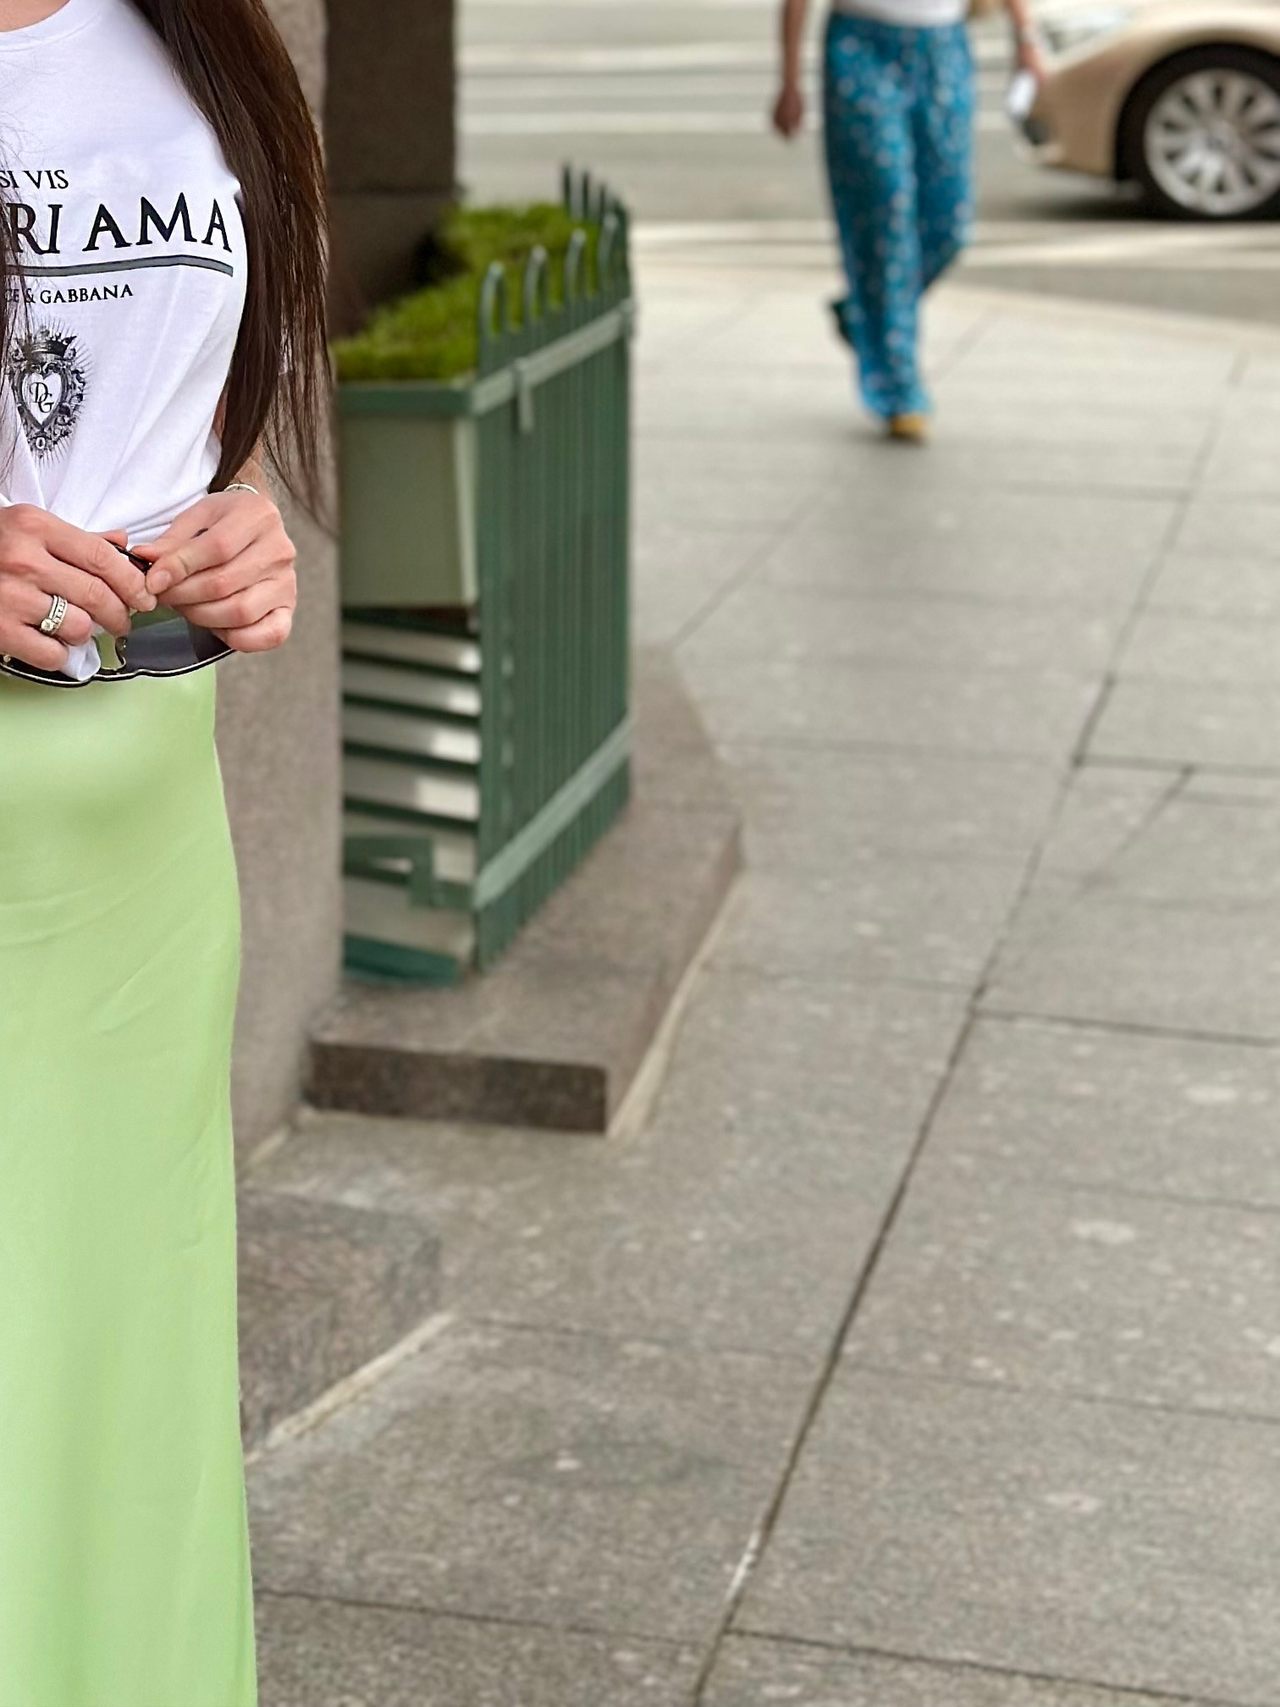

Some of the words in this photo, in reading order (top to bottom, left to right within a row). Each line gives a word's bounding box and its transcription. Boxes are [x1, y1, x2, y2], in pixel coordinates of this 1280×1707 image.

[24, 169, 69, 190] VIS
[82, 192, 233, 254] AMA
[39, 283, 134, 305] GABBANA
